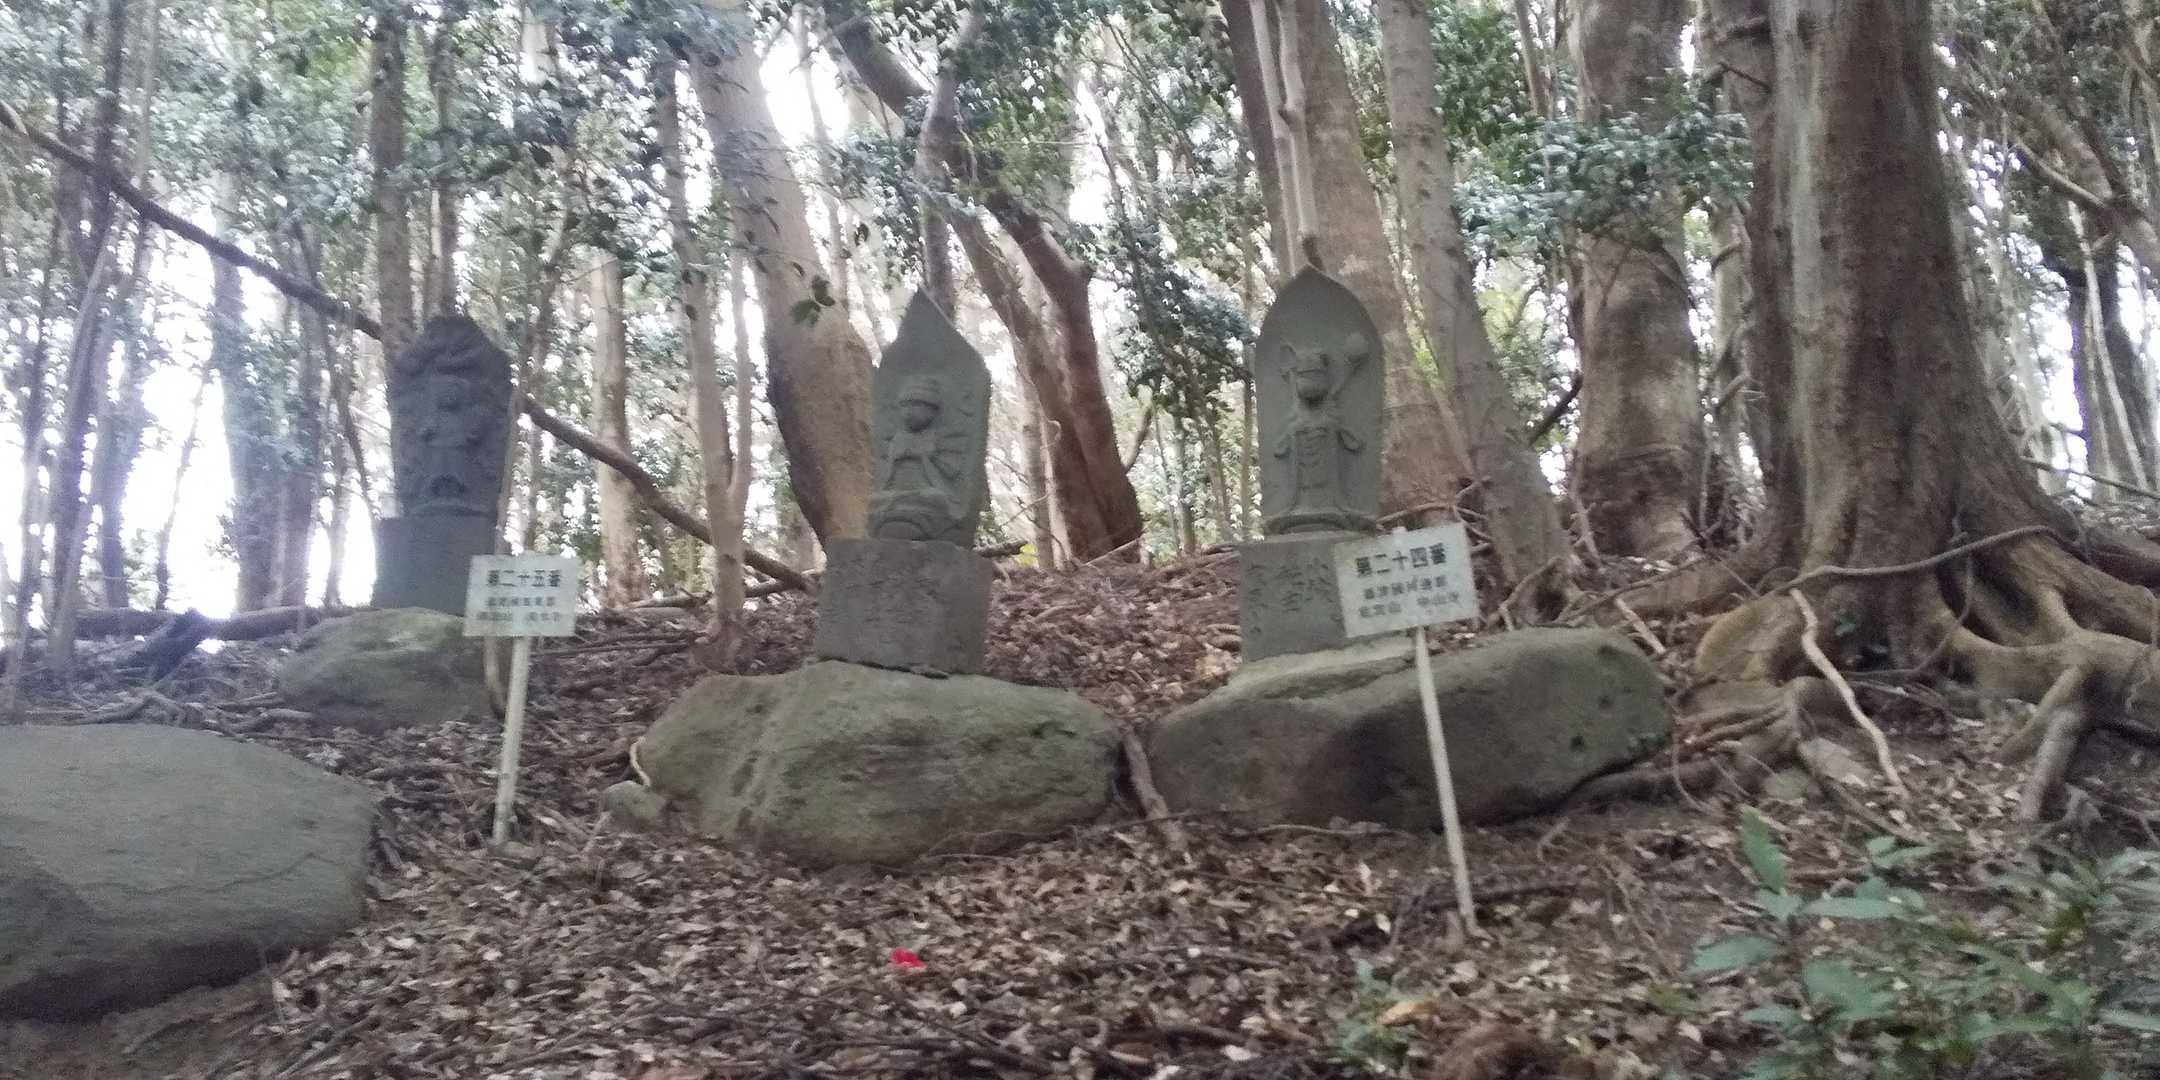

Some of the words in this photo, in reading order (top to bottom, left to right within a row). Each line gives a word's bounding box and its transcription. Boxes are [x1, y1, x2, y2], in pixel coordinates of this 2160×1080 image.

[1355, 542, 1447, 578] 第二十四番
[488, 569, 562, 588] 第二十五番
